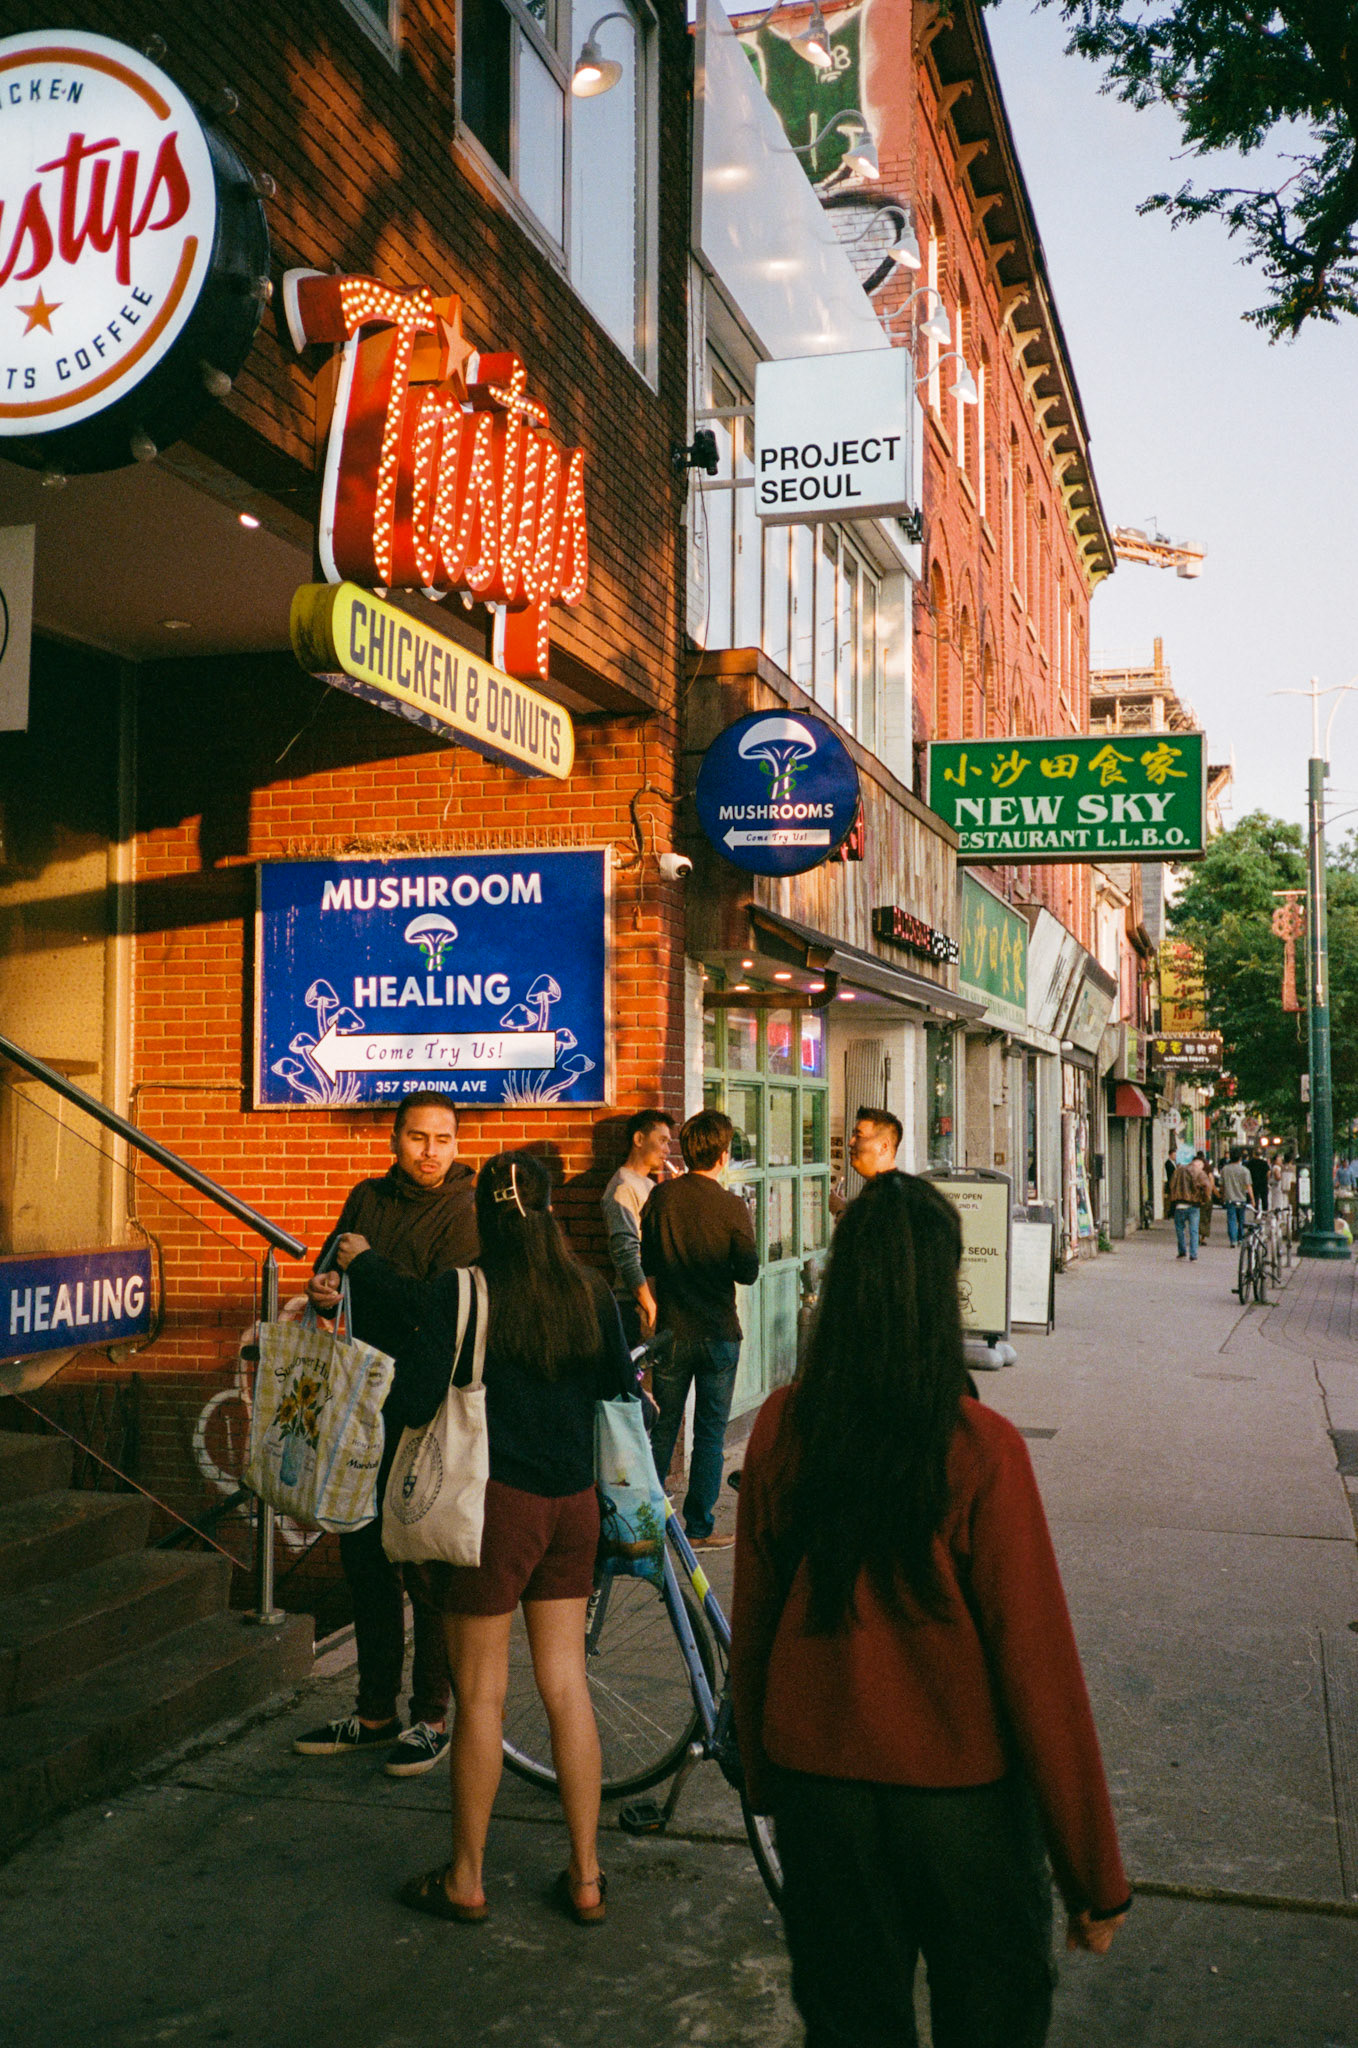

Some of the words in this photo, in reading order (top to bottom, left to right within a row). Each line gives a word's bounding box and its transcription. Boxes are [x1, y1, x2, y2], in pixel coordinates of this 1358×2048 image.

[0, 79, 84, 109] CKEN
[0, 130, 191, 289] stys
[56, 286, 153, 381] COFFEE
[761, 436, 901, 472] PROJECT
[760, 473, 862, 504] SEOUL
[350, 599, 458, 713] CHICKEN
[466, 667, 479, 723] &
[487, 677, 561, 766] DONUTS
[944, 742, 1188, 788] 小沙田食家
[719, 803, 834, 820] MUSHROOMS
[954, 795, 1065, 827] NEW
[1077, 792, 1176, 824] SKY
[746, 833, 768, 842] Come
[771, 832, 788, 844] Try
[793, 832, 808, 841] Us!
[957, 830, 1091, 849] ESTAURANT
[1096, 827, 1191, 847] L.L.B.O.
[321, 872, 543, 911] MUSHROOM
[354, 973, 511, 1008] HEALING
[365, 1044, 415, 1060] Come
[424, 1038, 461, 1067] Try
[471, 1041, 503, 1059] Us!
[375, 1081, 400, 1093] 357
[402, 1080, 458, 1093] SPADINA
[461, 1080, 487, 1092] AVE
[962, 1193, 983, 1201] OPEN
[968, 1246, 999, 1256] SEOUL
[10, 1275, 145, 1335] HEALING
